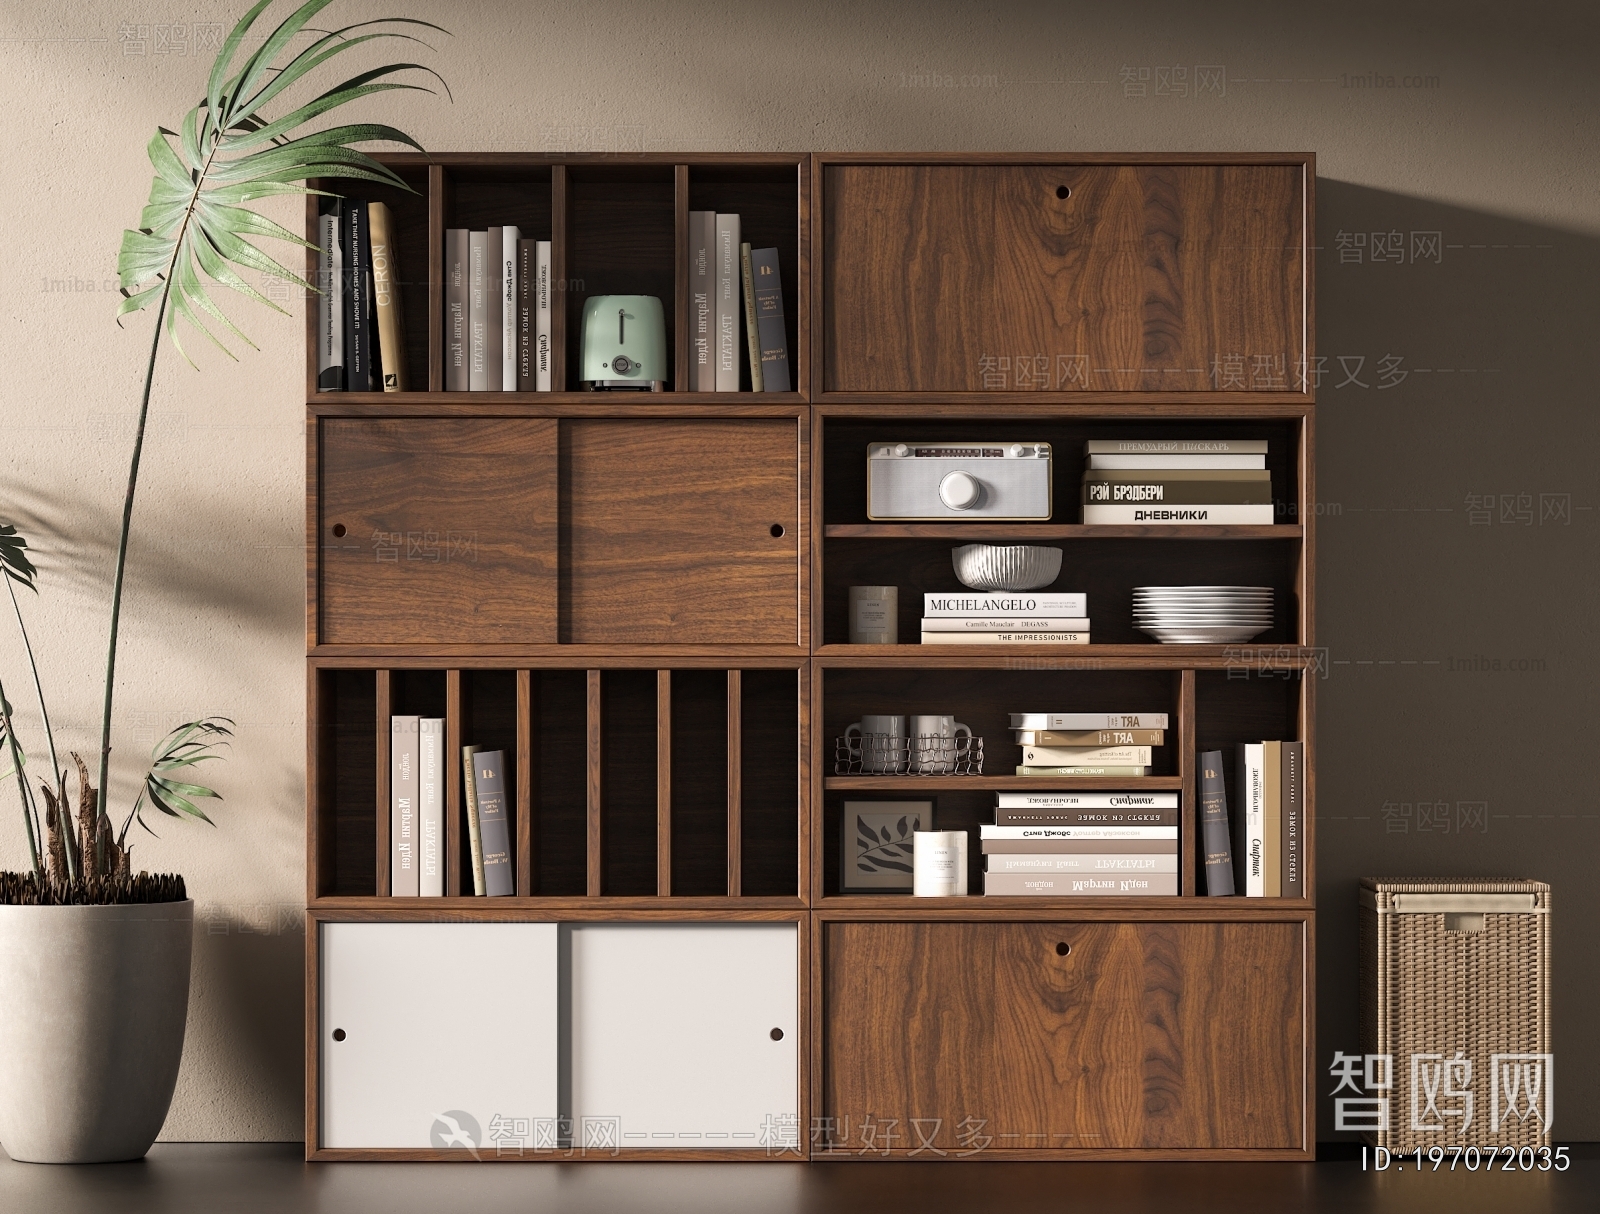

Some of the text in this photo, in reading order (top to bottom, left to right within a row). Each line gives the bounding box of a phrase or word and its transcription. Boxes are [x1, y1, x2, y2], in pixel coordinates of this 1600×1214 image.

[351, 208, 359, 225] TAKE
[371, 245, 391, 306] CERON
[1119, 441, 1178, 452] ПРЕМУДРЫЙ
[1090, 482, 1164, 501] РЭЙ БРЭДБЕРИ
[1134, 510, 1208, 521] ДНЕВНИКИ
[930, 599, 1037, 611] MICHELANGELO
[1289, 840, 1296, 851] из
[1249, 838, 1262, 878] Спартак
